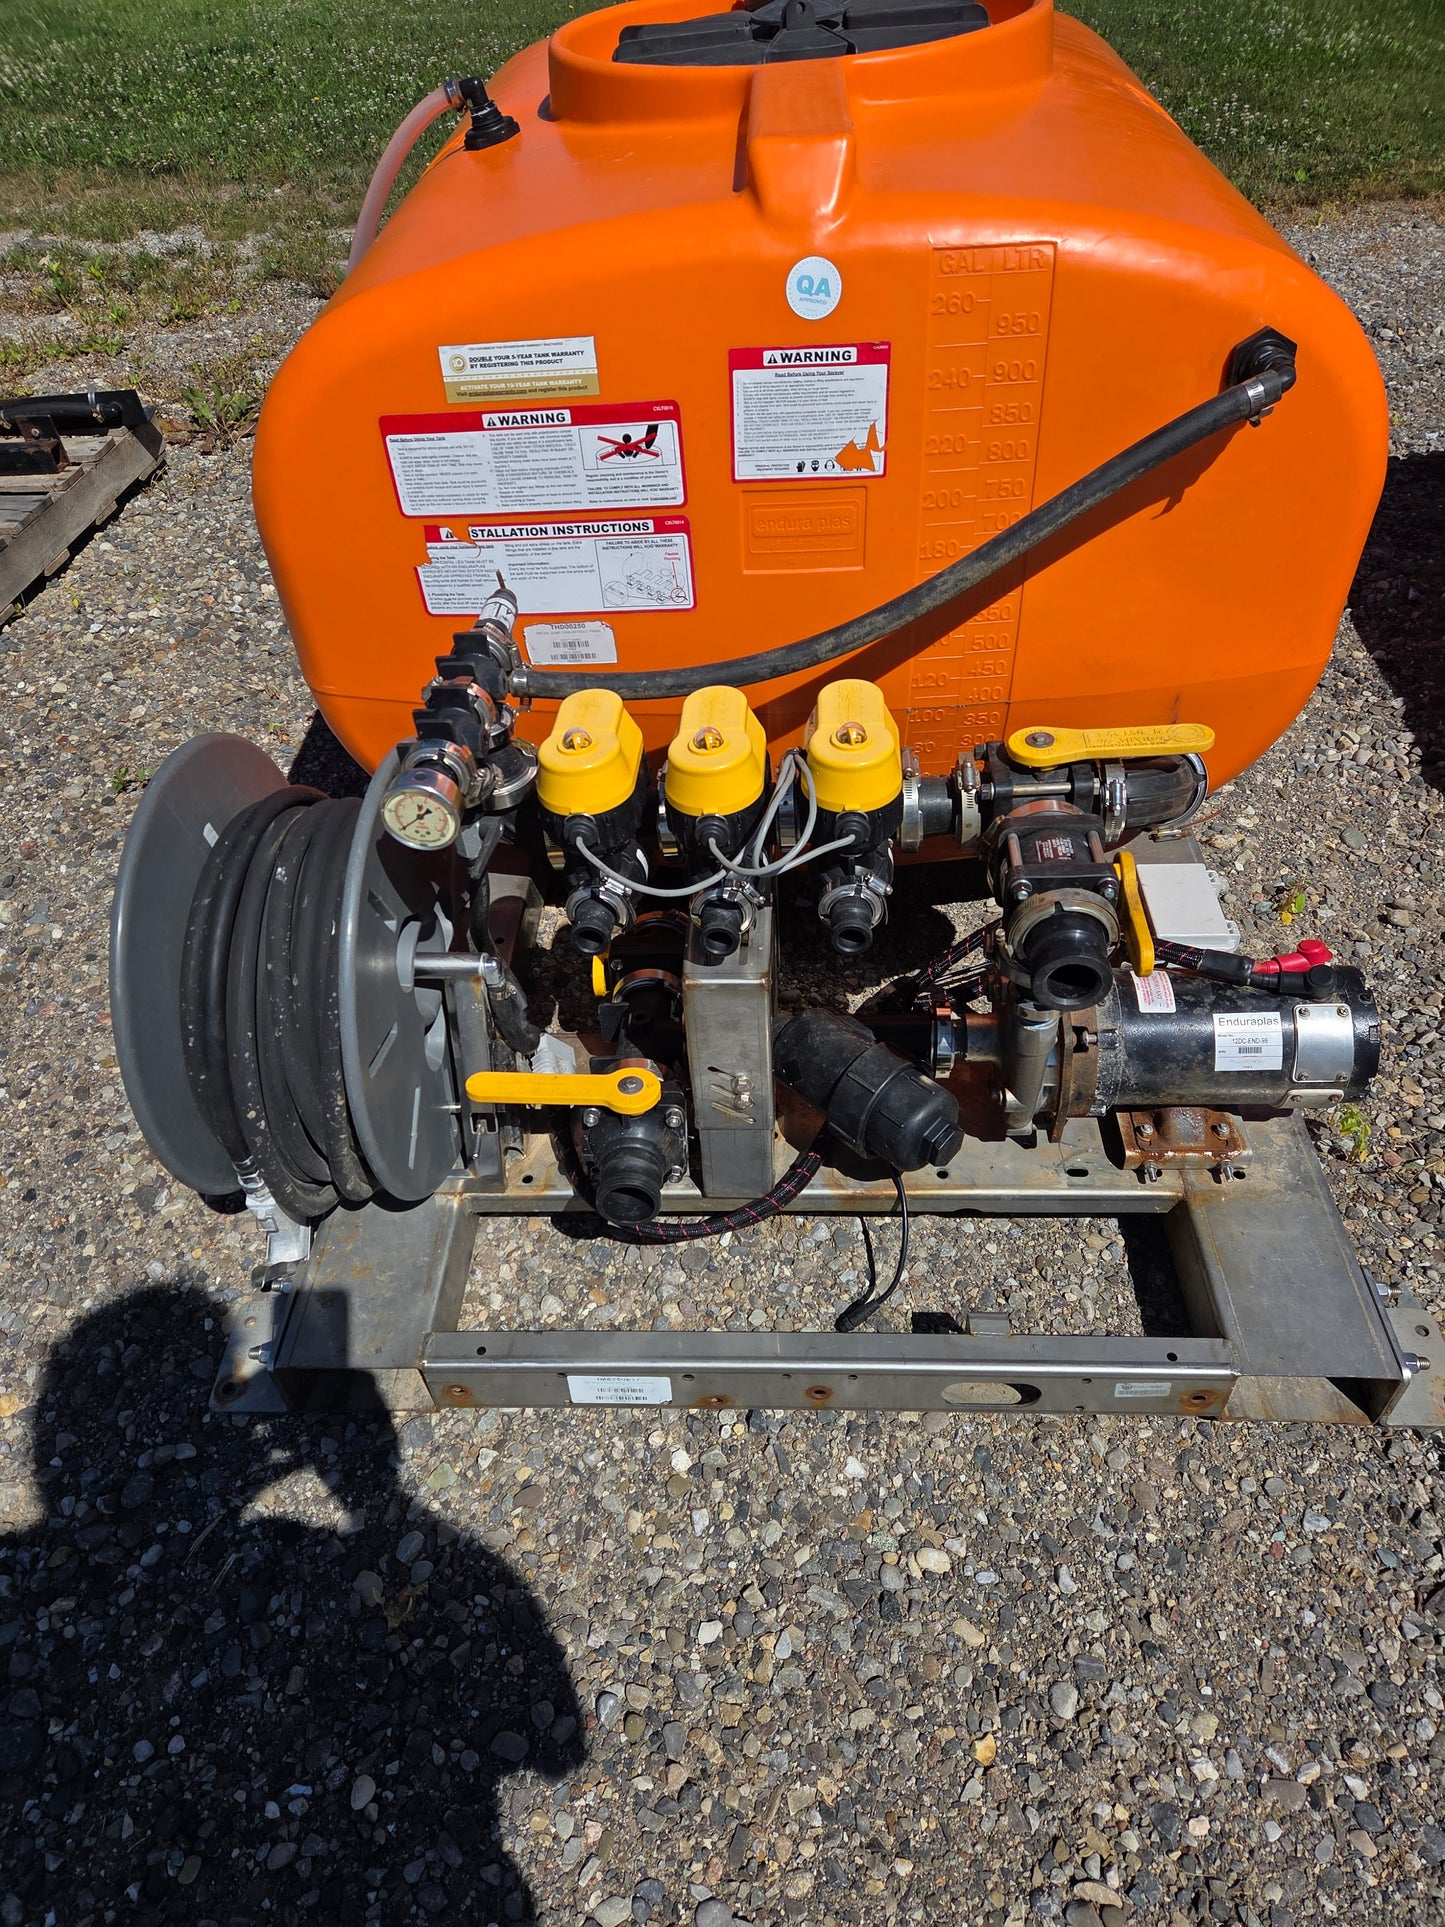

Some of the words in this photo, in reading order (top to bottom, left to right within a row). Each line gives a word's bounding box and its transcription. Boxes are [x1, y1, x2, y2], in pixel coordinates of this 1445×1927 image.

[939, 250, 984, 274] GAL
[1002, 248, 1044, 271] LTR
[796, 274, 831, 298] QA
[931, 291, 976, 316] 260
[996, 312, 1042, 336] 950
[780, 350, 852, 364] WARNING
[928, 367, 972, 390] 240
[993, 360, 1038, 383] 900
[498, 412, 565, 426] WARNING
[990, 402, 1033, 424] 850
[925, 434, 967, 456] 220
[987, 440, 1030, 461] 800
[985, 478, 1026, 498] 750
[922, 488, 963, 510] 200
[470, 525, 549, 538] STALLATION
[552, 522, 650, 535] INSTRUCTIONS
[756, 515, 812, 532] endura
[817, 513, 852, 532] plas
[920, 539, 959, 560] 180
[972, 632, 1011, 650] 500
[968, 660, 1007, 677] 450
[912, 672, 948, 688] 120
[966, 686, 1004, 702] 400
[910, 708, 945, 722] 100
[963, 712, 1000, 726] 350
[960, 732, 997, 746] 300
[1218, 1017, 1279, 1027] Enduraplas
